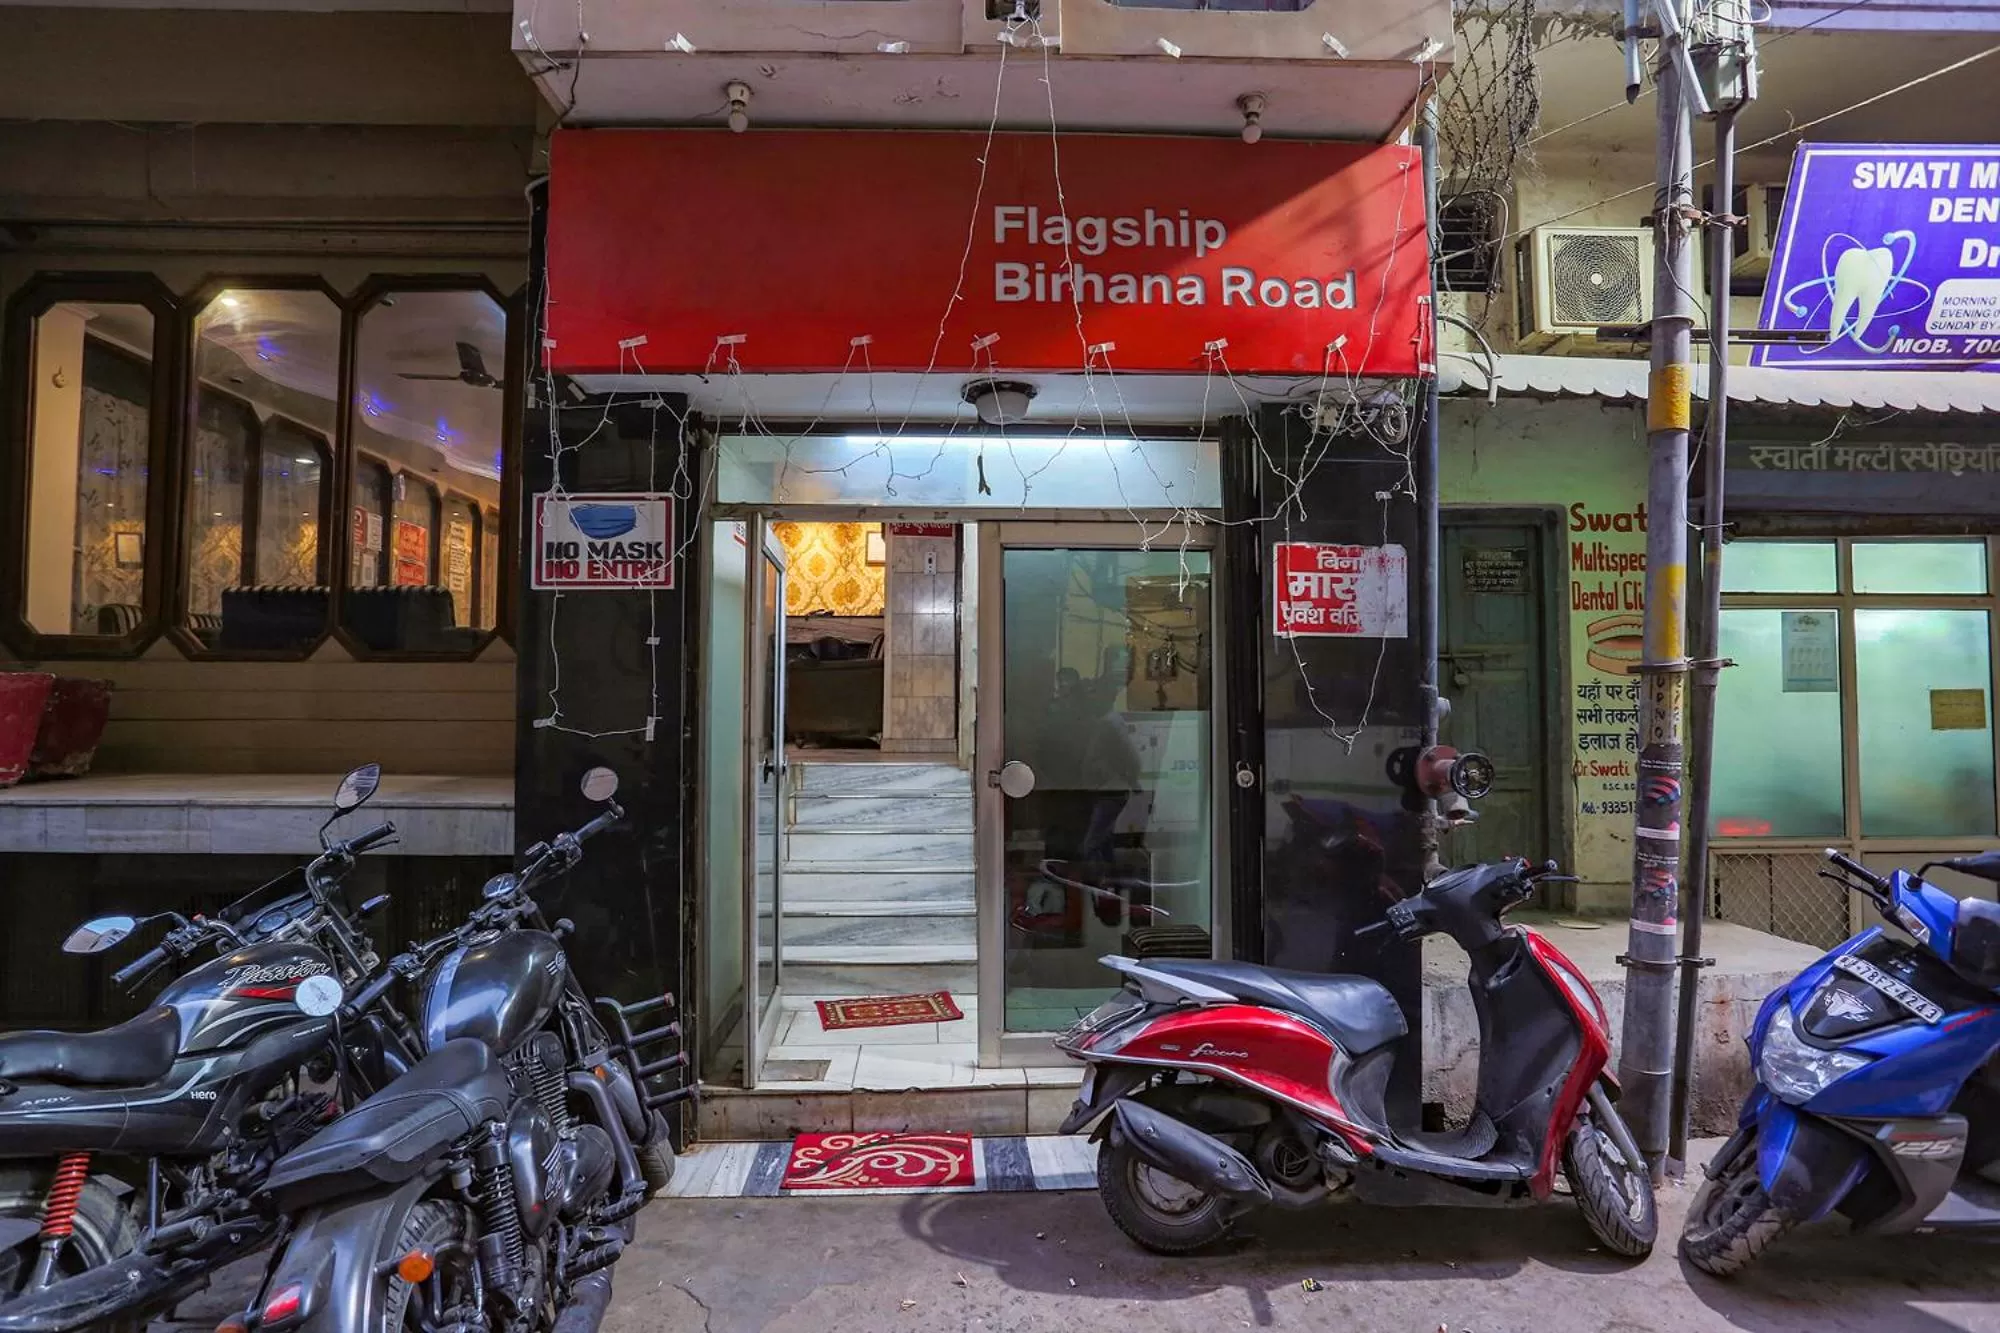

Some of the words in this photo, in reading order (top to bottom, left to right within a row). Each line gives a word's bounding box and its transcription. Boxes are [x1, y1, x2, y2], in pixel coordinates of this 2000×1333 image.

[1852, 161, 1961, 189] SWATI
[1928, 197, 2000, 223] DEN
[994, 205, 1228, 258] Flagship
[994, 262, 1206, 305] Birhana
[1222, 266, 1355, 310] Road
[1942, 296, 1998, 306] MORNING
[1940, 308, 1990, 318] EVENING
[1930, 321, 1976, 331] SUNDAY
[1980, 321, 1995, 331] BY
[1892, 338, 1952, 354] MOB.
[1570, 502, 1648, 533] Swat
[545, 541, 580, 560] NO
[587, 541, 665, 560] MASK
[1571, 541, 1648, 577] Multispec
[545, 560, 580, 580] NO
[587, 560, 665, 580] ENTRY
[1571, 580, 1619, 611] Dental
[1605, 685, 1624, 701] पर
[1578, 733, 1621, 754] इलाज
[1589, 759, 1630, 777] Swati
[218, 959, 331, 989] Passion
